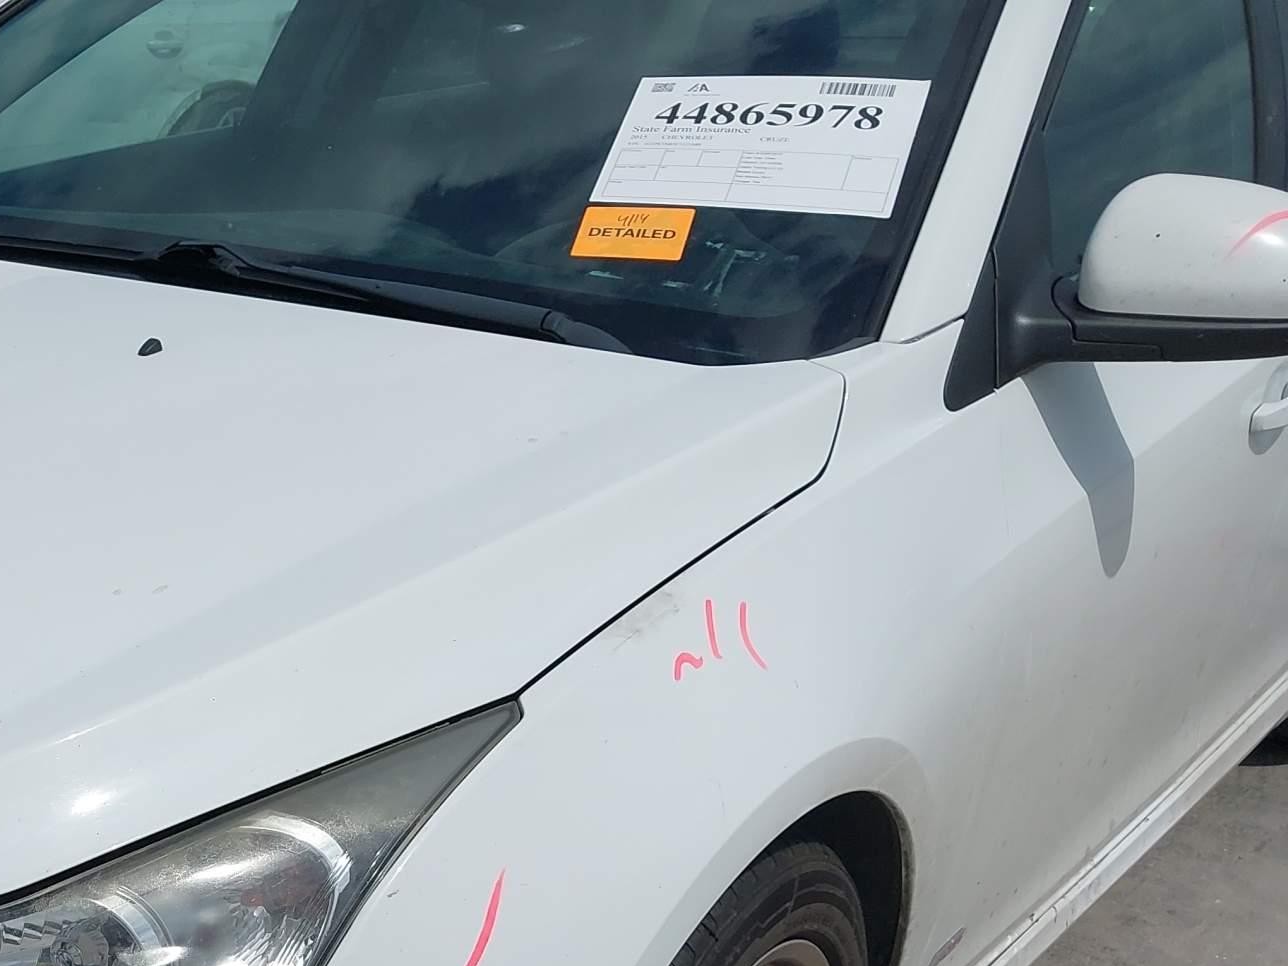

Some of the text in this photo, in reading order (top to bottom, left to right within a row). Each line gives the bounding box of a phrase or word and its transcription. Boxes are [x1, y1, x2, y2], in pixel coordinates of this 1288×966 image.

[655, 102, 883, 130] 44865978
[632, 125, 752, 134] State Farm Insurance
[588, 227, 677, 239] DETAILED
